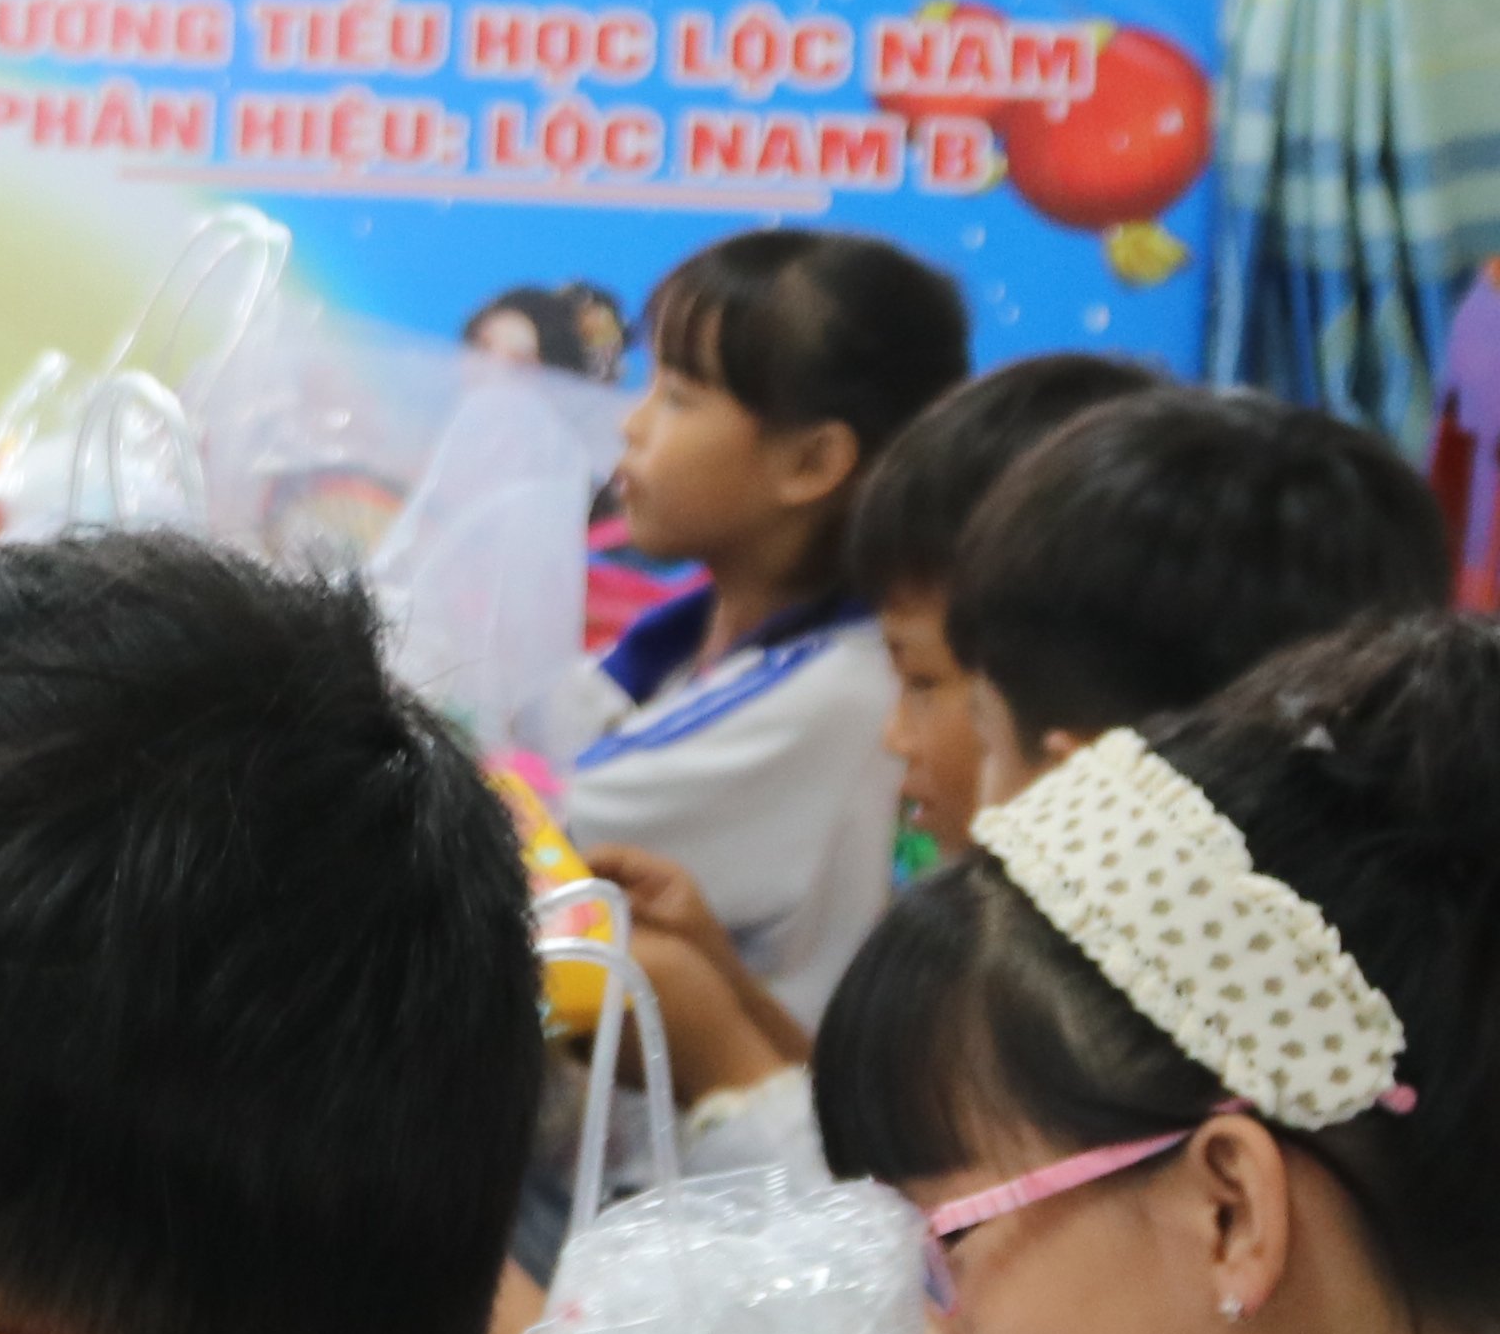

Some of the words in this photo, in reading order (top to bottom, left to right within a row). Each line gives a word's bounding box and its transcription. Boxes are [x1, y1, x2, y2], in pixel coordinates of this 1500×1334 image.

[474, 13, 646, 87] HỌC
[680, 7, 843, 91] LỘC
[493, 95, 653, 179] LỘC
[688, 123, 893, 180] NAM
[928, 131, 982, 183] B
